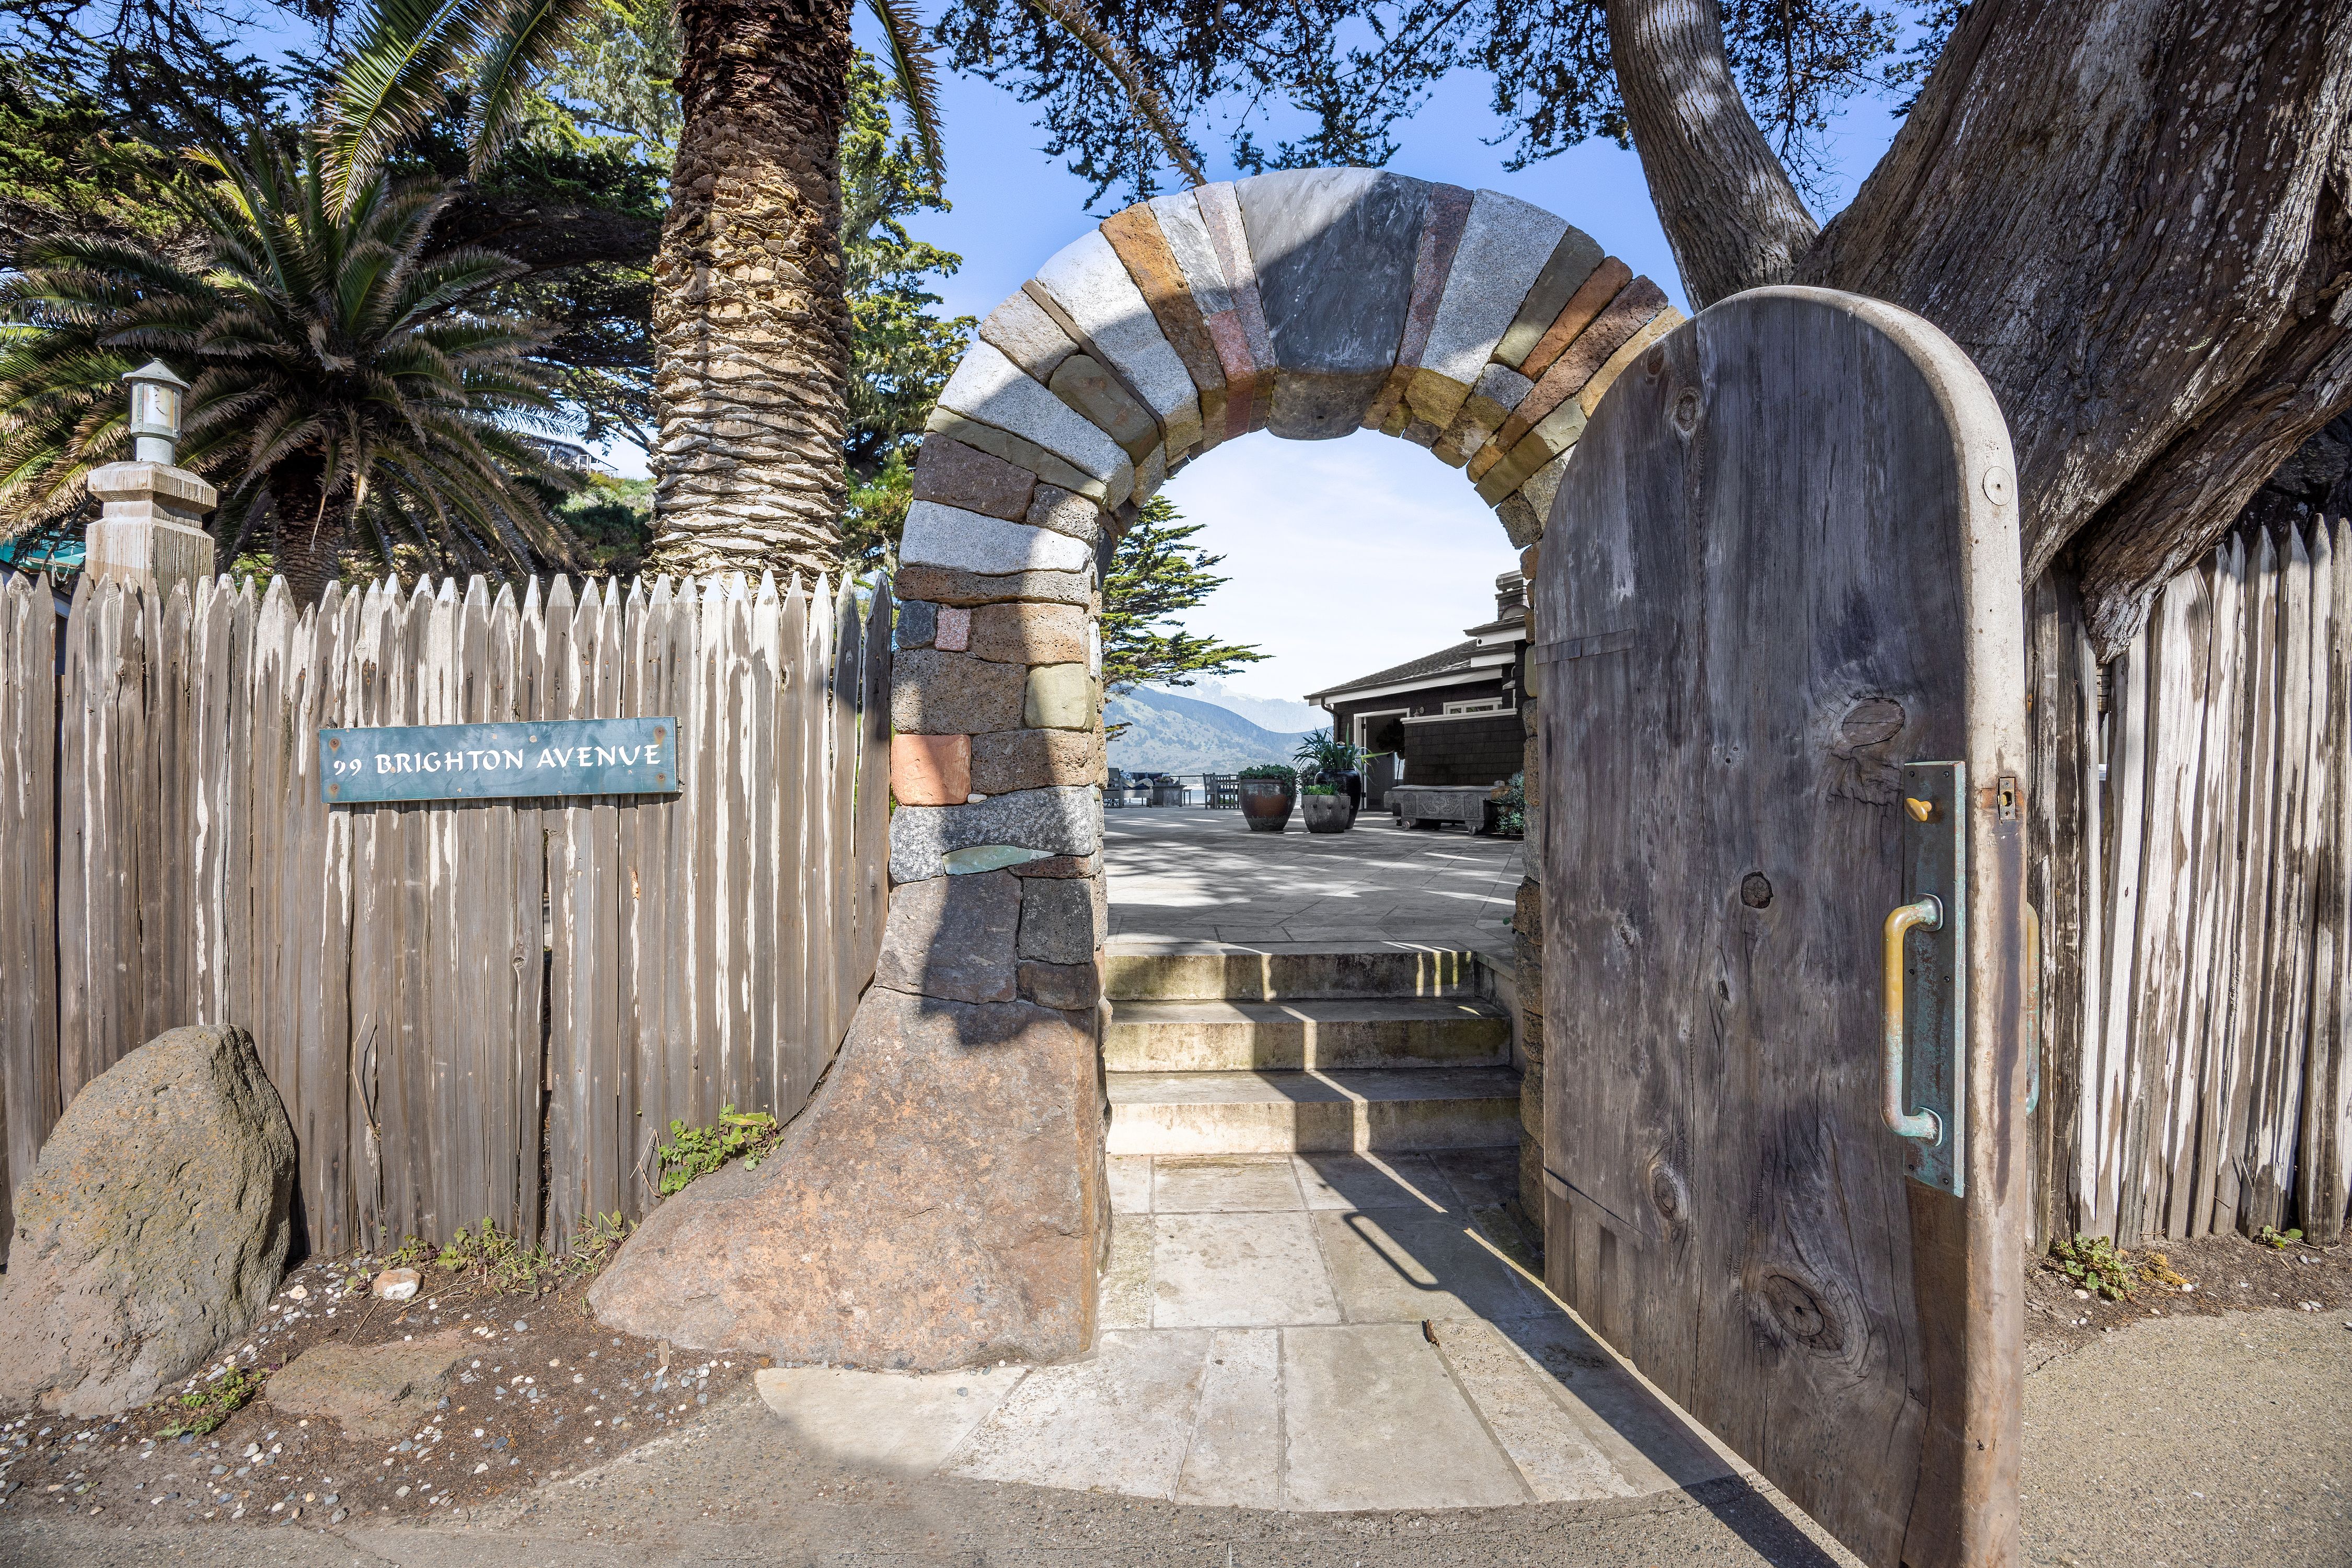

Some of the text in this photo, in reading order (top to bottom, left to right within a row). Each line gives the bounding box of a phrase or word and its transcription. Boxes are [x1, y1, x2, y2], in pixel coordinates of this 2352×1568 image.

[333, 744, 661, 776] 99 BRIGHTON AVENUE
